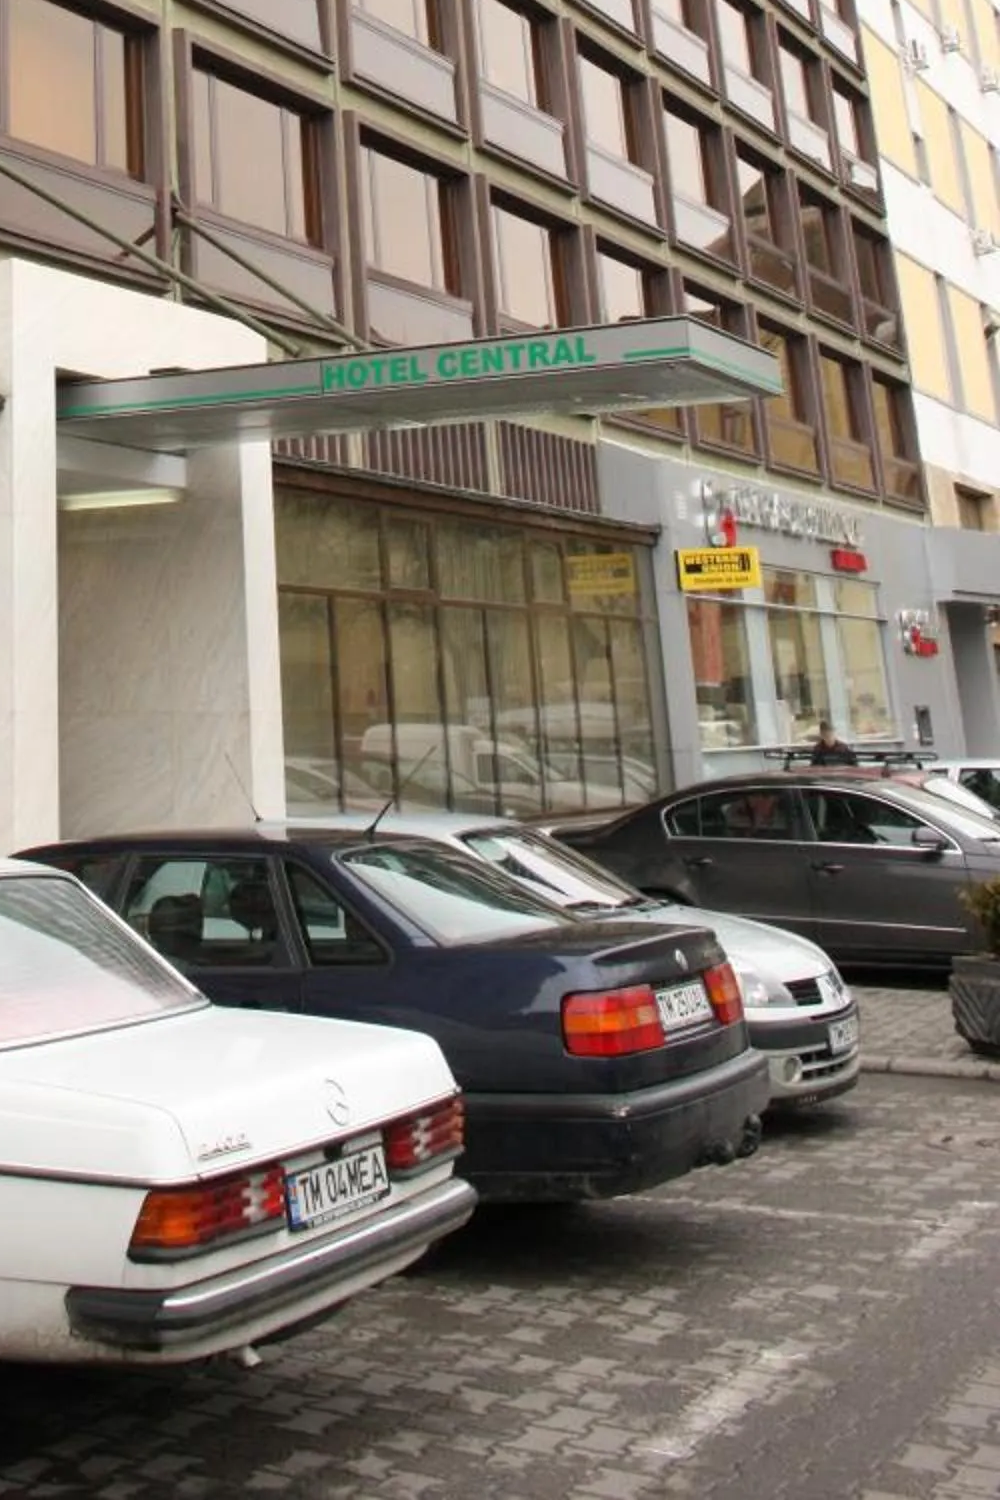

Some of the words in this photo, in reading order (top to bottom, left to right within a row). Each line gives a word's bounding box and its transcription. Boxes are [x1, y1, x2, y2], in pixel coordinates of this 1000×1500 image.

[323, 357, 427, 391] HOTEL
[436, 335, 596, 378] CENTRAL
[298, 1171, 324, 1215] TM
